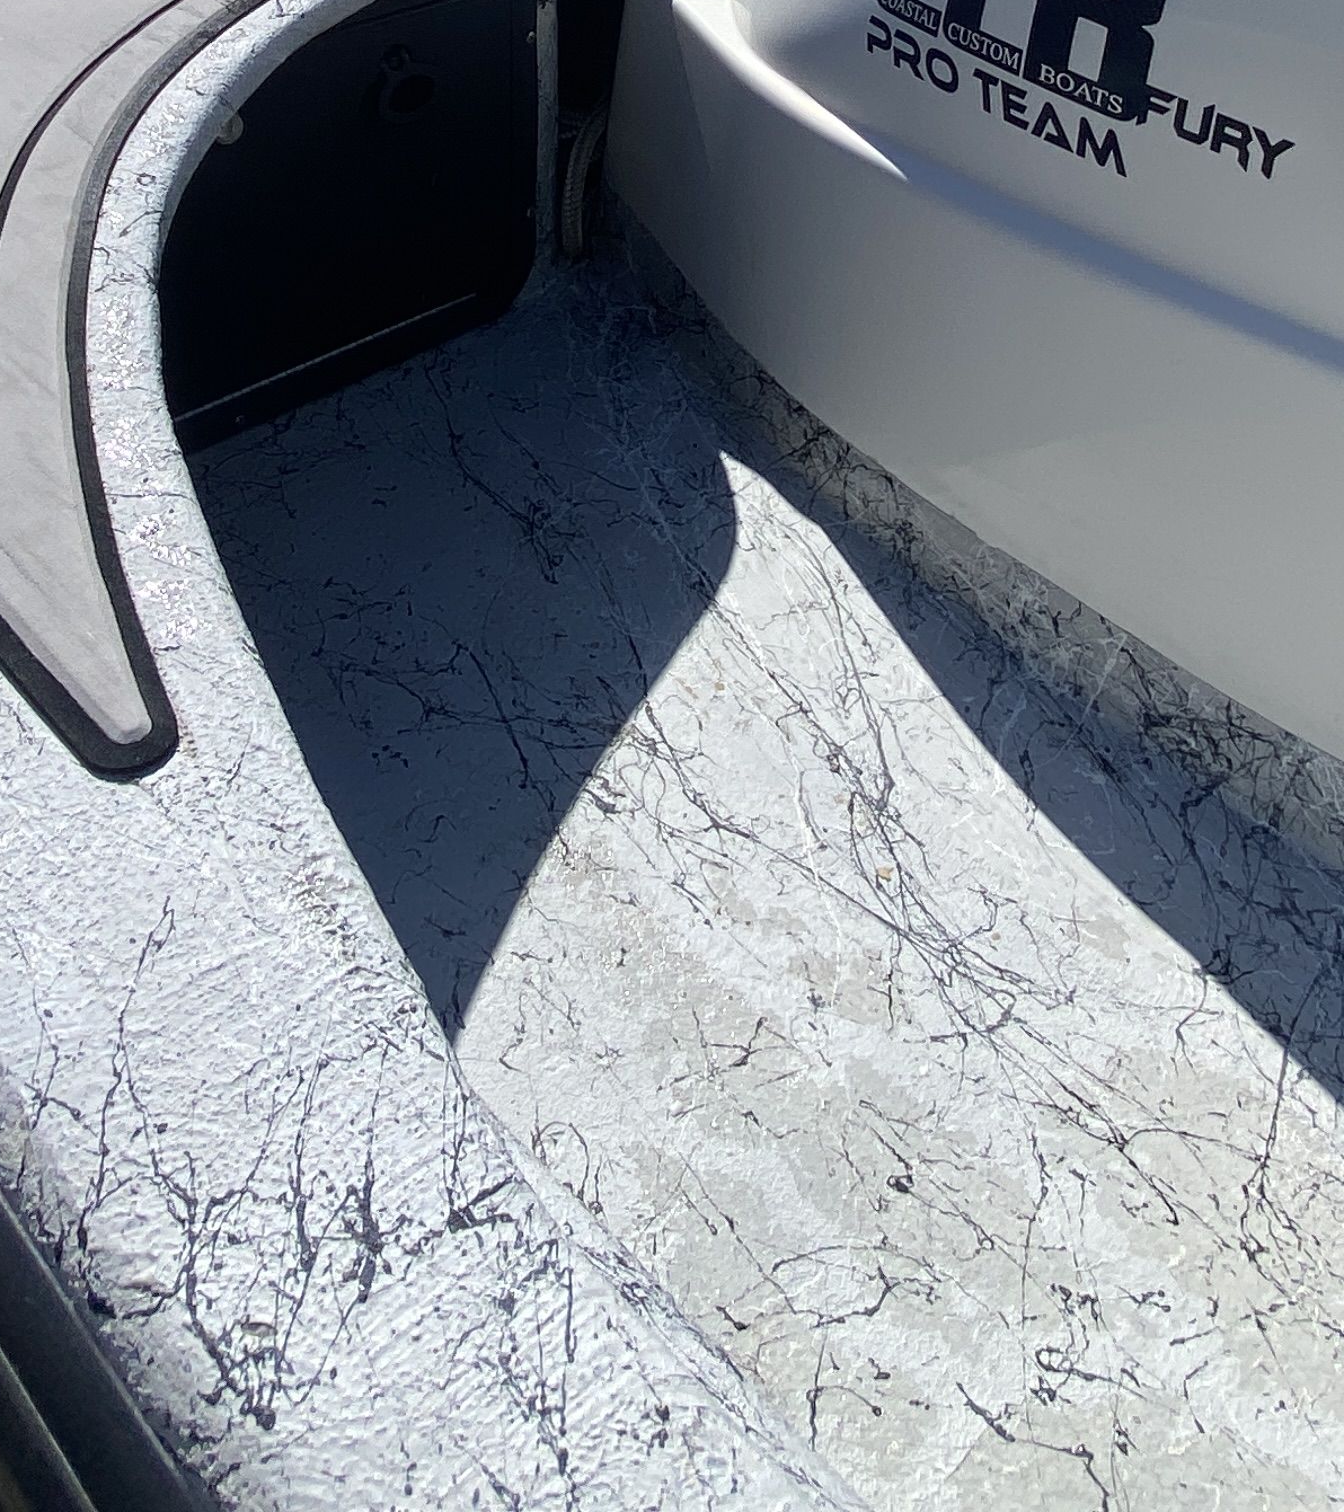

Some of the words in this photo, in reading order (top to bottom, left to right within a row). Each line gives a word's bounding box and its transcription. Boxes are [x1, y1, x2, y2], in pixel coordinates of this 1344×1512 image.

[866, 15, 960, 94] PRO
[973, 67, 1128, 179] TEAM
[946, 22, 1021, 71] CUSTOM
[1038, 63, 1124, 115] BOATS
[1136, 84, 1296, 180] FURY
